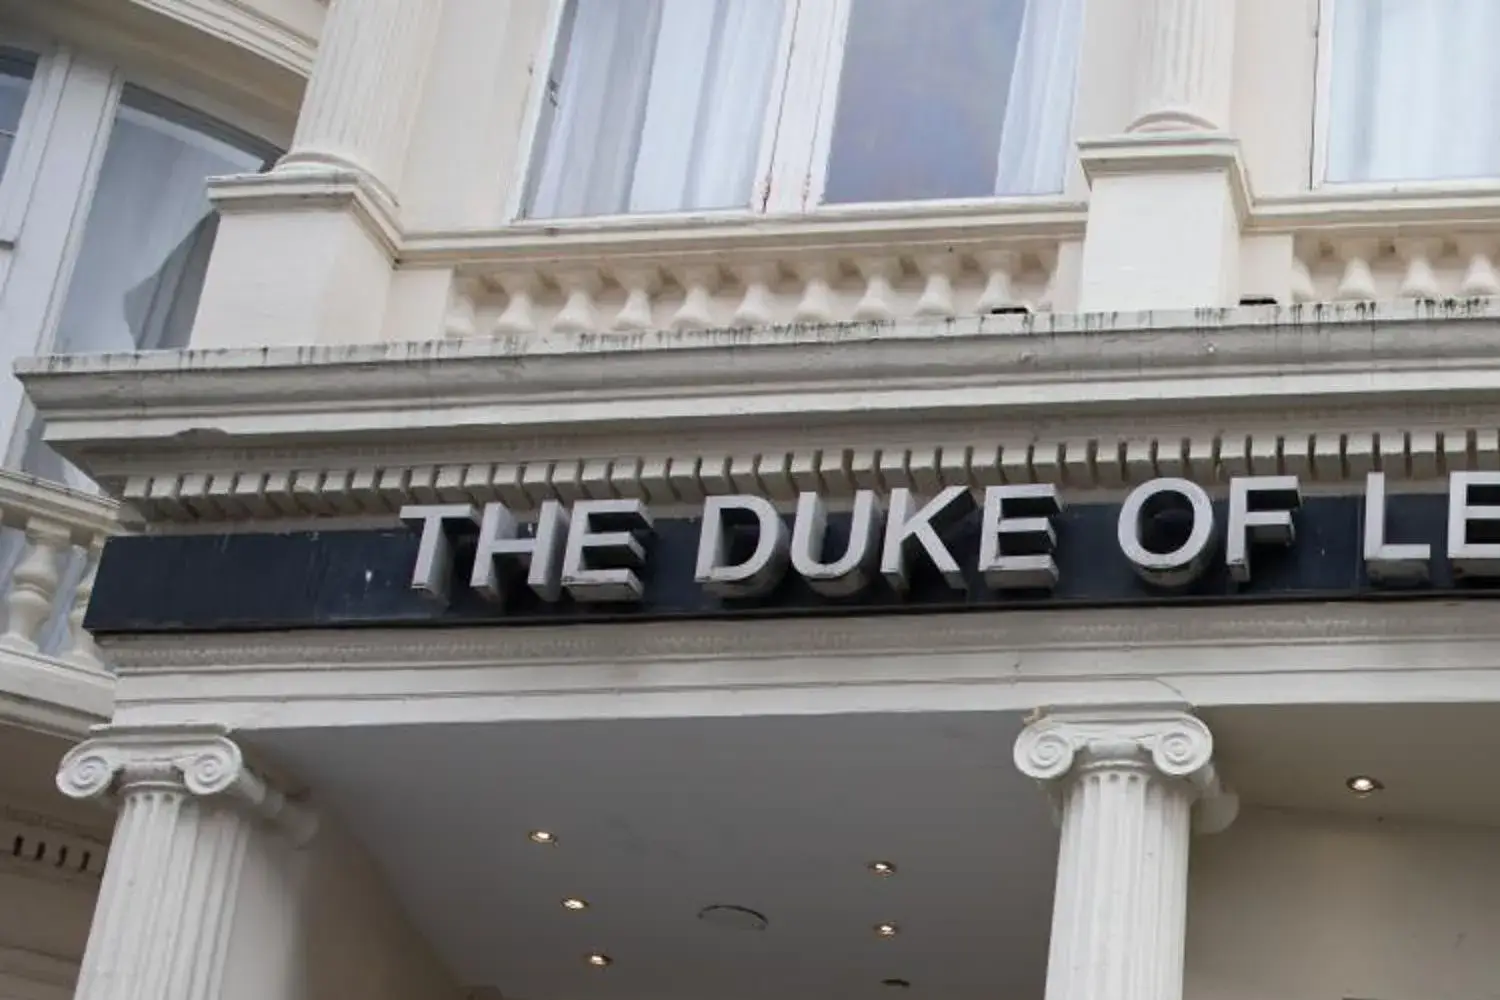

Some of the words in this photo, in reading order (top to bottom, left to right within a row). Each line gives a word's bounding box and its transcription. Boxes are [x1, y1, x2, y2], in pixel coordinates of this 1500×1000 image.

[400, 498, 646, 592] THE
[694, 484, 1061, 586] DUKE
[1117, 476, 1299, 576] OF
